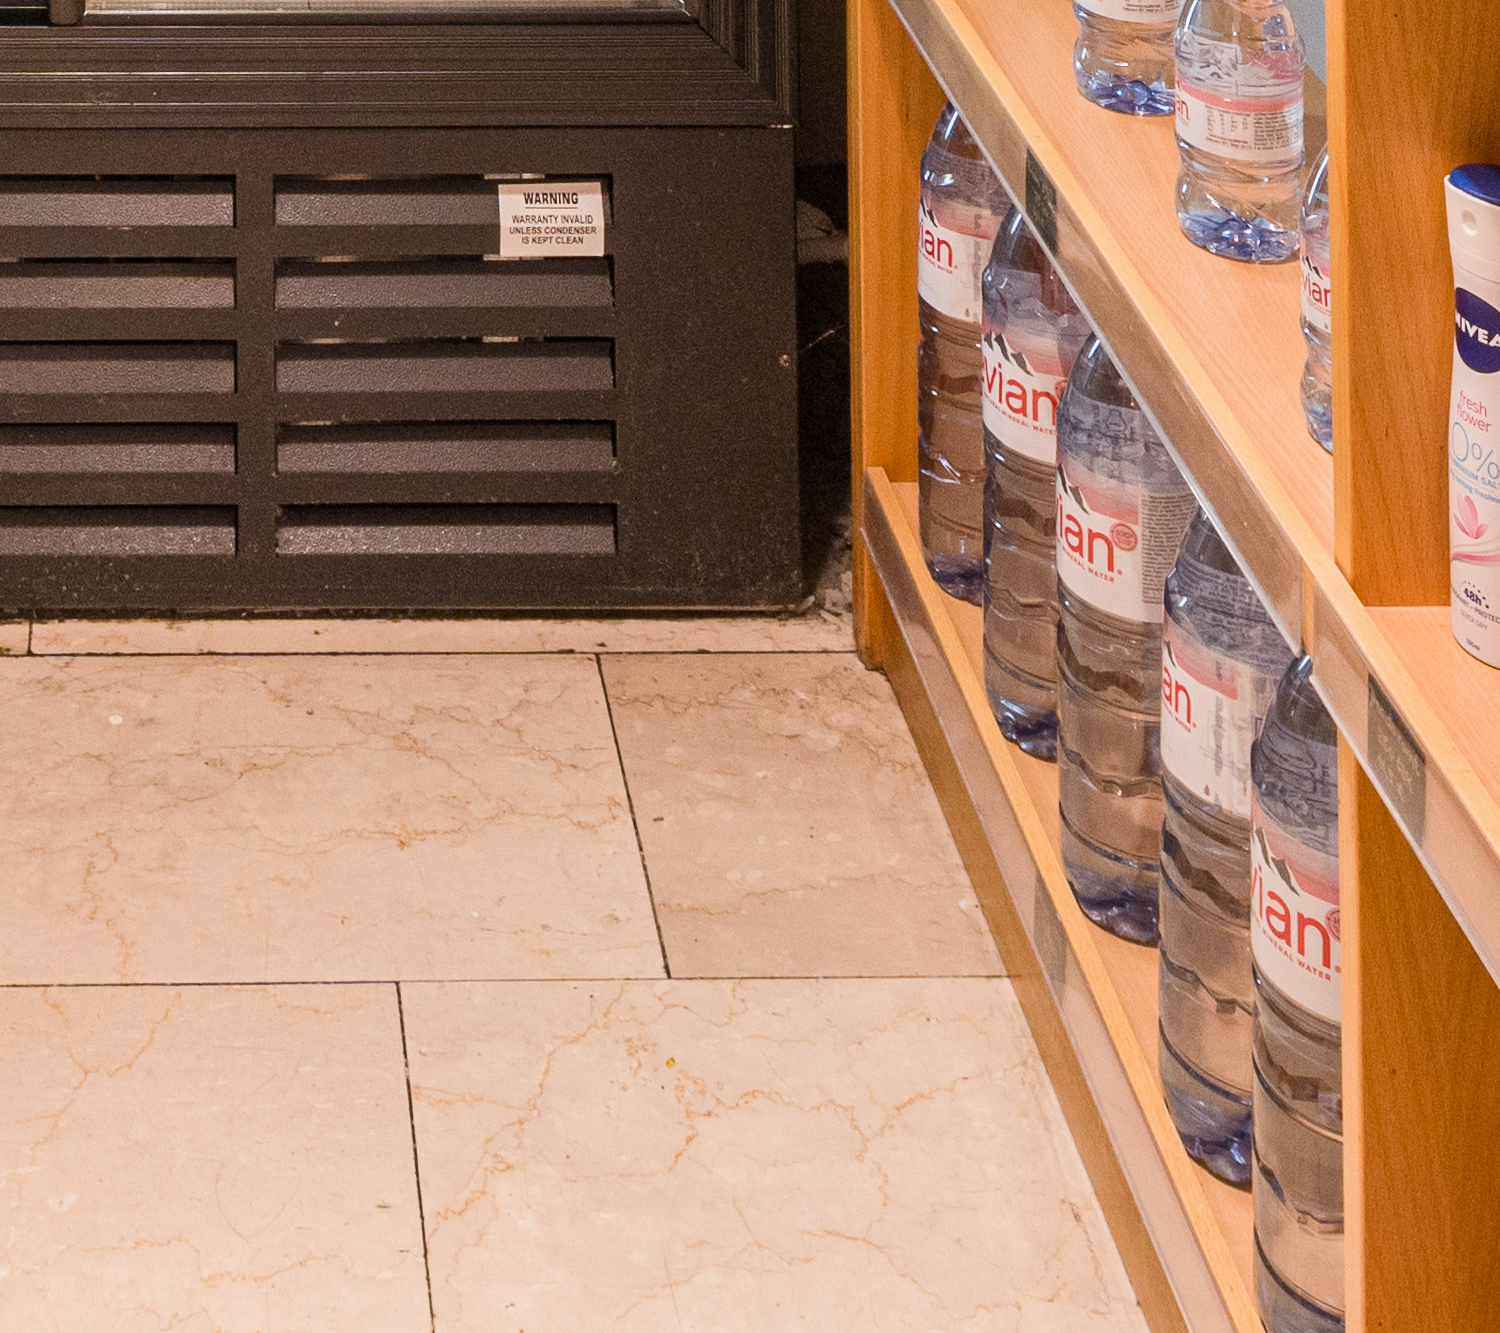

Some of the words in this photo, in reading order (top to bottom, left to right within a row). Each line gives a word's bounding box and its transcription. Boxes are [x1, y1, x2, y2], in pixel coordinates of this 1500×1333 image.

[523, 192, 579, 204] WARNING
[512, 215, 558, 224] WARRANTY
[561, 215, 593, 224] INVALID
[509, 227, 541, 235] UNLESS
[1459, 390, 1488, 418] fresh
[1456, 403, 1492, 434] flower
